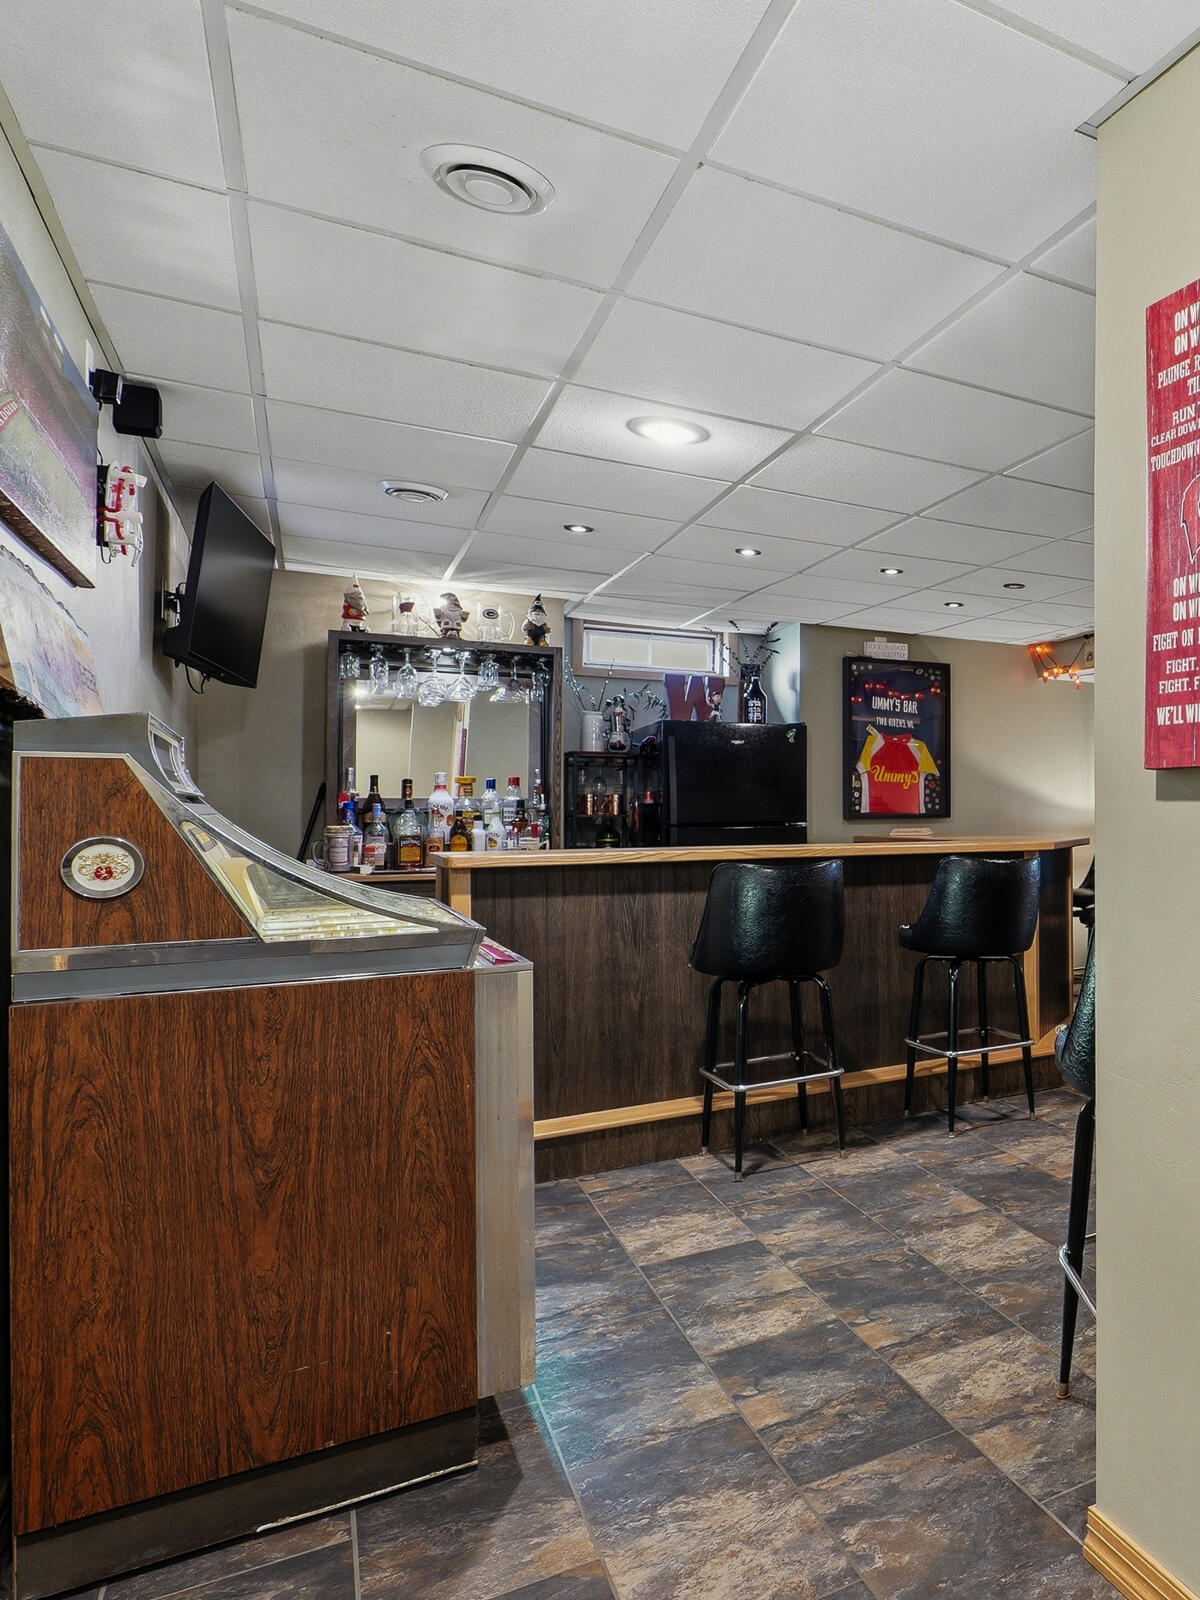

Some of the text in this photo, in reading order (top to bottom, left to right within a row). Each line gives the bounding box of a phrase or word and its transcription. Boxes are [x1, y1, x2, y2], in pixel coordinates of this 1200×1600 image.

[1174, 307, 1188, 332] ON
[1174, 332, 1188, 356] ON
[1157, 359, 1191, 389] PLUNGE
[1172, 403, 1196, 426] RUN
[1151, 428, 1177, 447] CLEAR
[1151, 439, 1200, 472] TOUCHDOWN
[1173, 576, 1186, 598] ON
[1172, 600, 1186, 622] ON
[1153, 631, 1178, 652] FIGHT
[1181, 628, 1194, 647] ON
[663, 673, 726, 721] W
[872, 696, 918, 714] UMMY'S BAR
[1156, 705, 1184, 726] WE'LL
